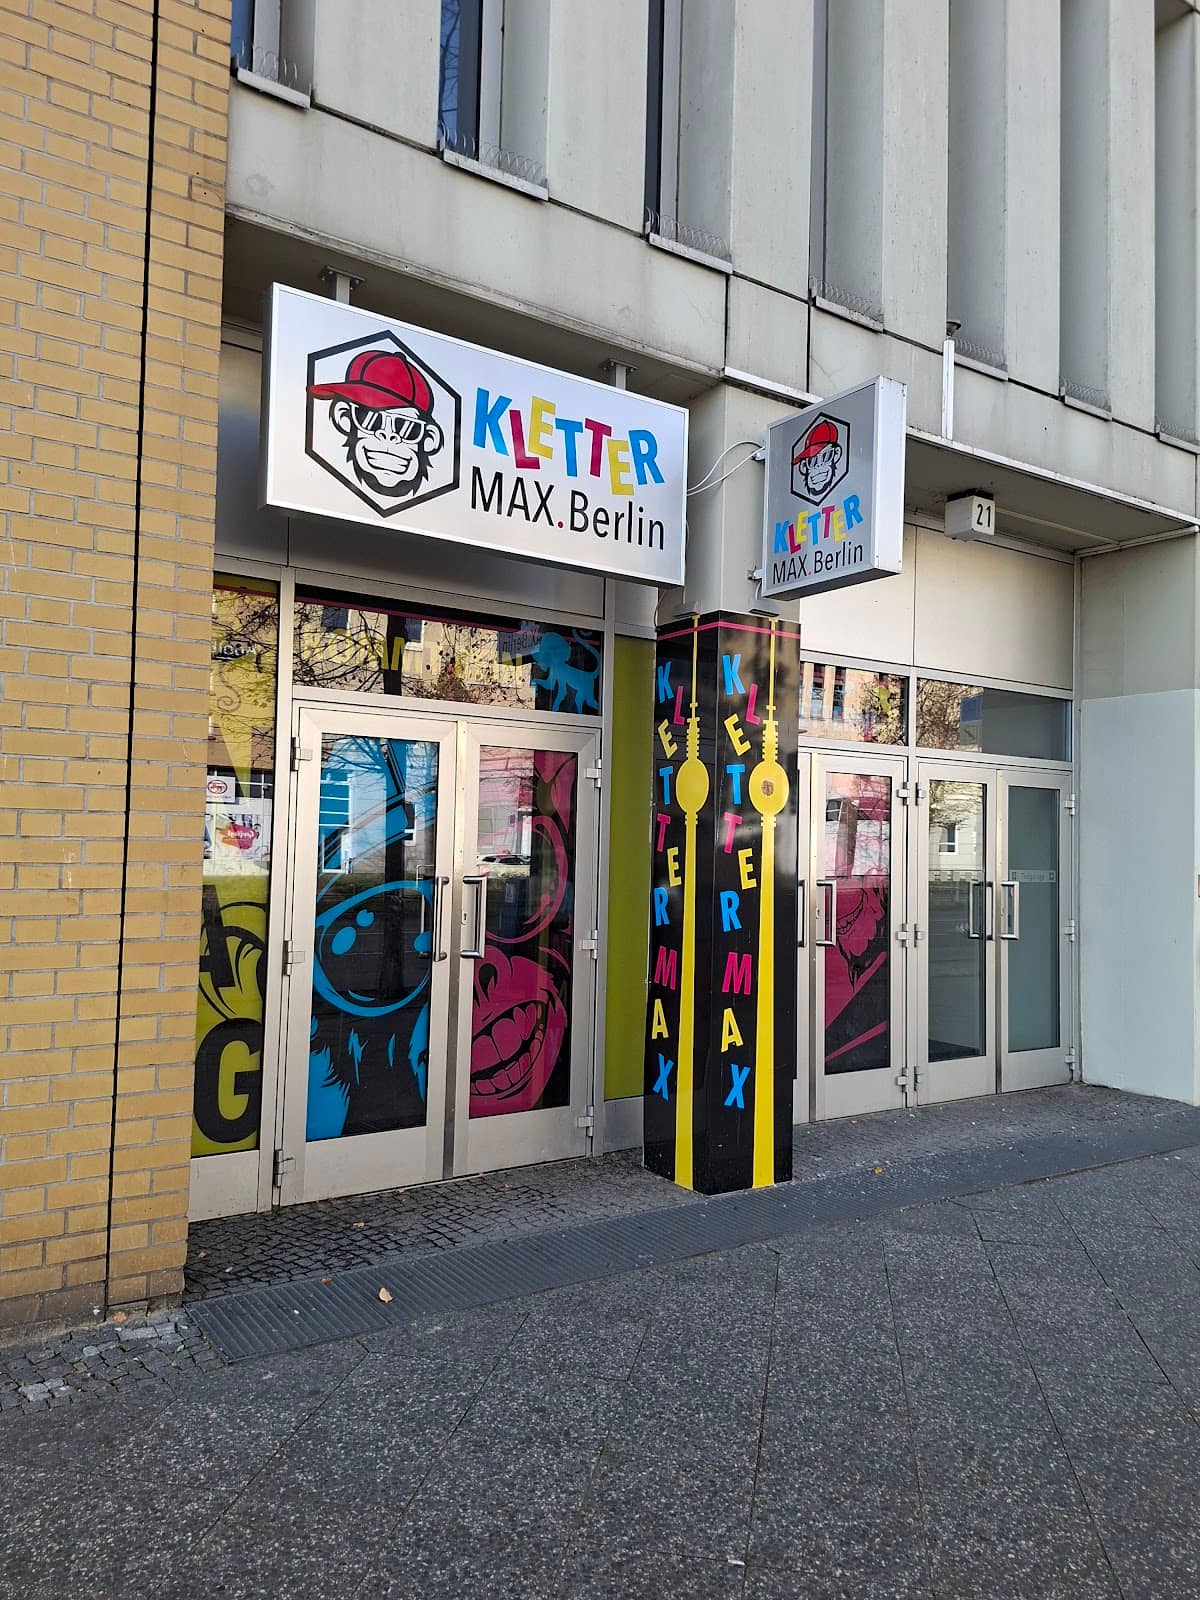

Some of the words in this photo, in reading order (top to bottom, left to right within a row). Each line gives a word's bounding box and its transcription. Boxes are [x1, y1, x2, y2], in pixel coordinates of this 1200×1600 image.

[472, 387, 665, 496] KLETTER
[471, 466, 665, 551] MAX.Berlin
[773, 494, 864, 555] KLETTER
[977, 503, 992, 528] 21
[772, 541, 864, 585] MAX.Berlin
